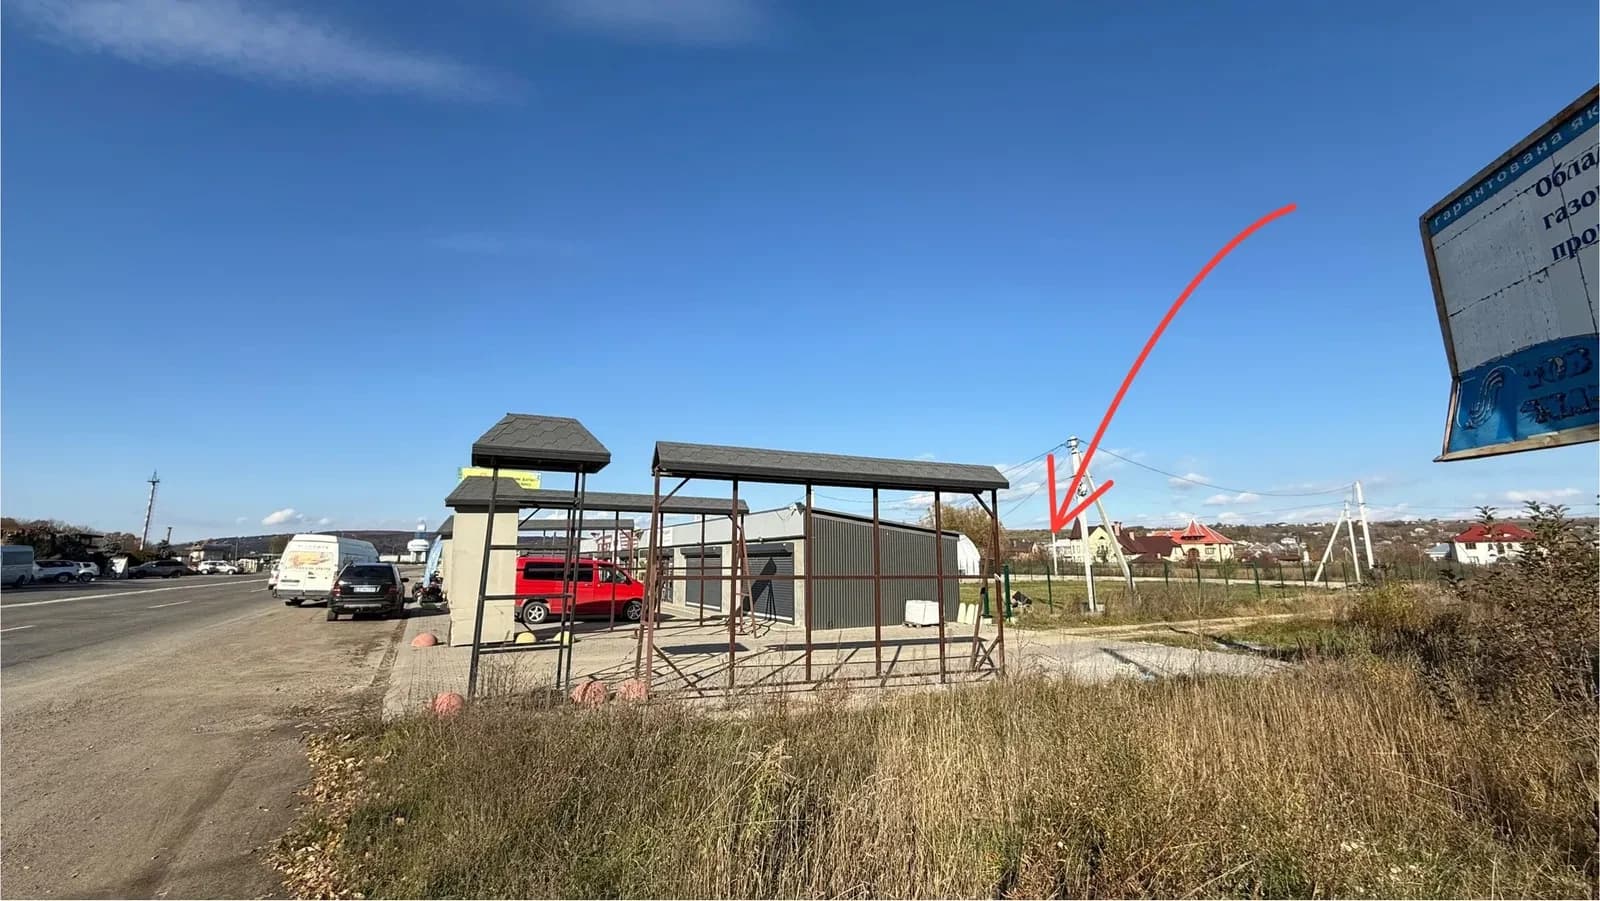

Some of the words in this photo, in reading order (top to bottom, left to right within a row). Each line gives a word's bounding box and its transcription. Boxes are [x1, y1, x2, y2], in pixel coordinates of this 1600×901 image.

[1434, 131, 1563, 227] гарантована
[1535, 149, 1599, 198] Обла
[1542, 185, 1599, 231] газо
[1551, 223, 1599, 261] про
